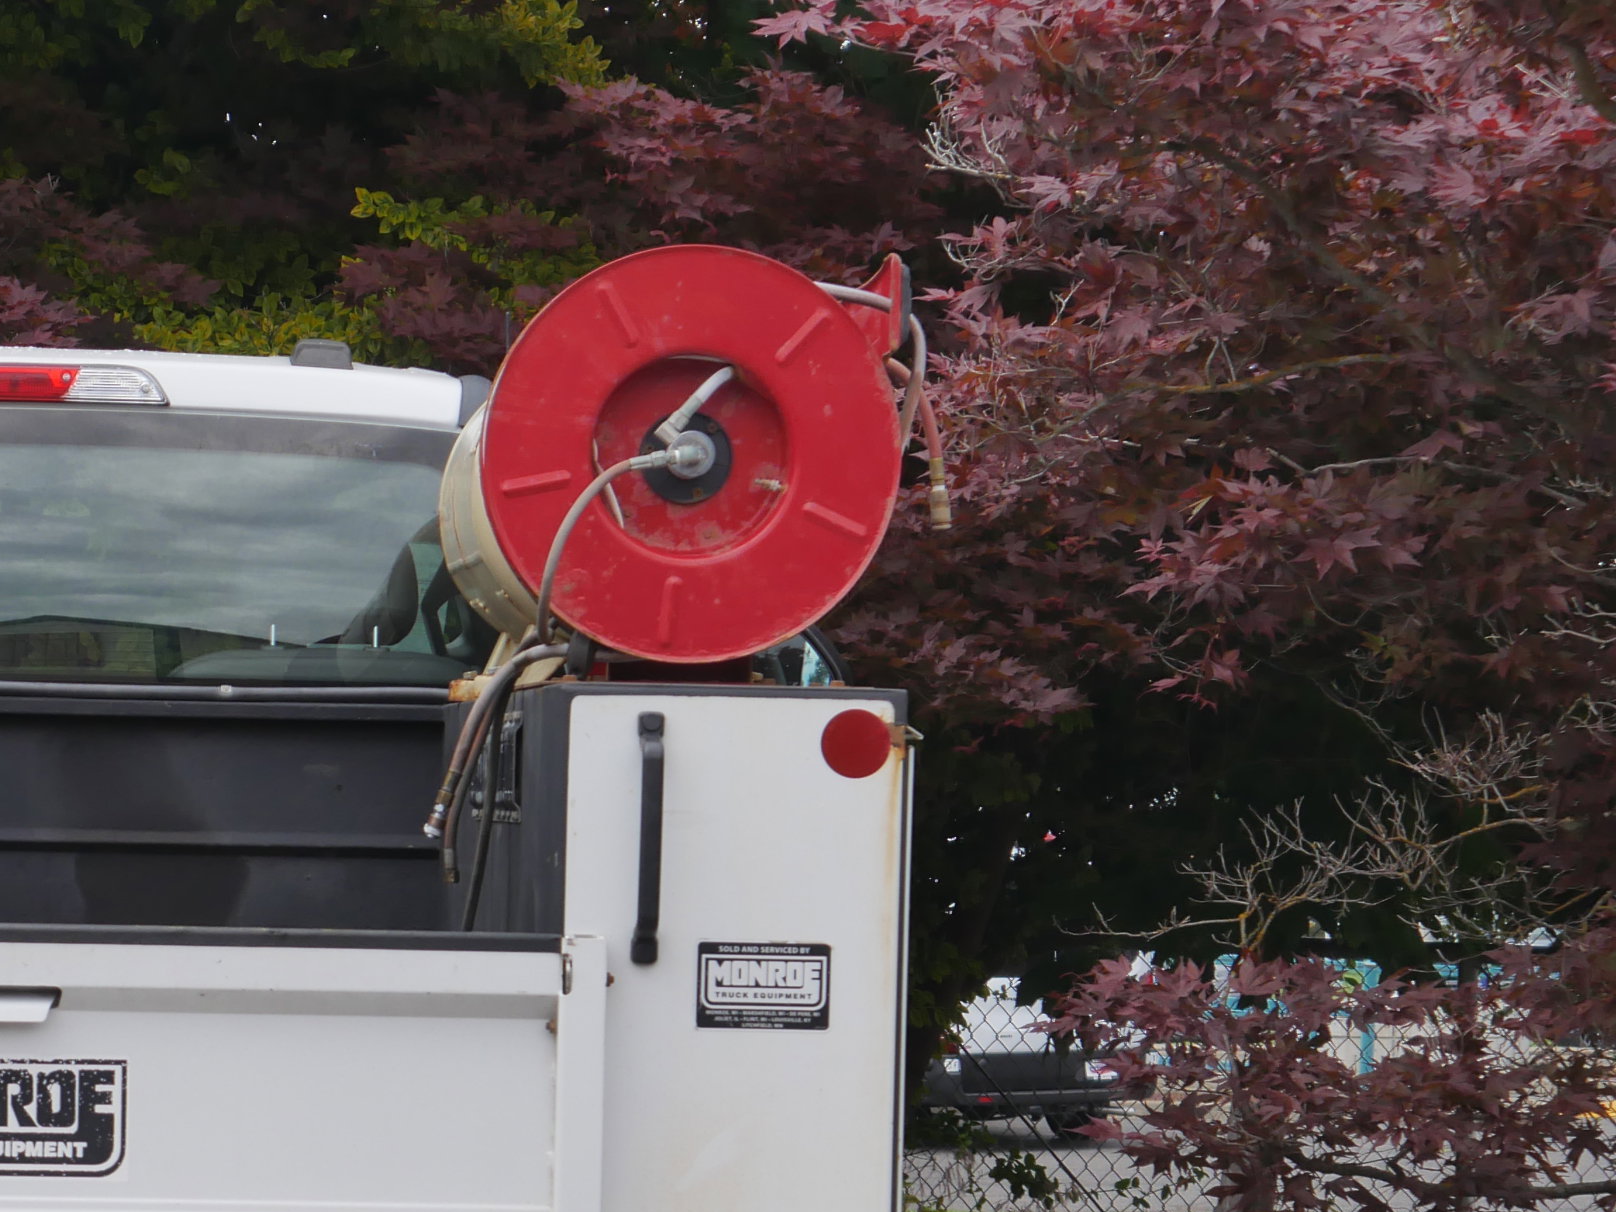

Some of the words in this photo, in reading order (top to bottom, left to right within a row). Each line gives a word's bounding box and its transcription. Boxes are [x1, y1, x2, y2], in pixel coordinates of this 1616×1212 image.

[718, 945, 740, 953] SOLD
[741, 946, 759, 954] AND
[760, 946, 799, 954] SERVICED
[707, 959, 822, 988] MONROE
[715, 991, 749, 999] TRUCK
[753, 992, 813, 1000] EQUIPMENT
